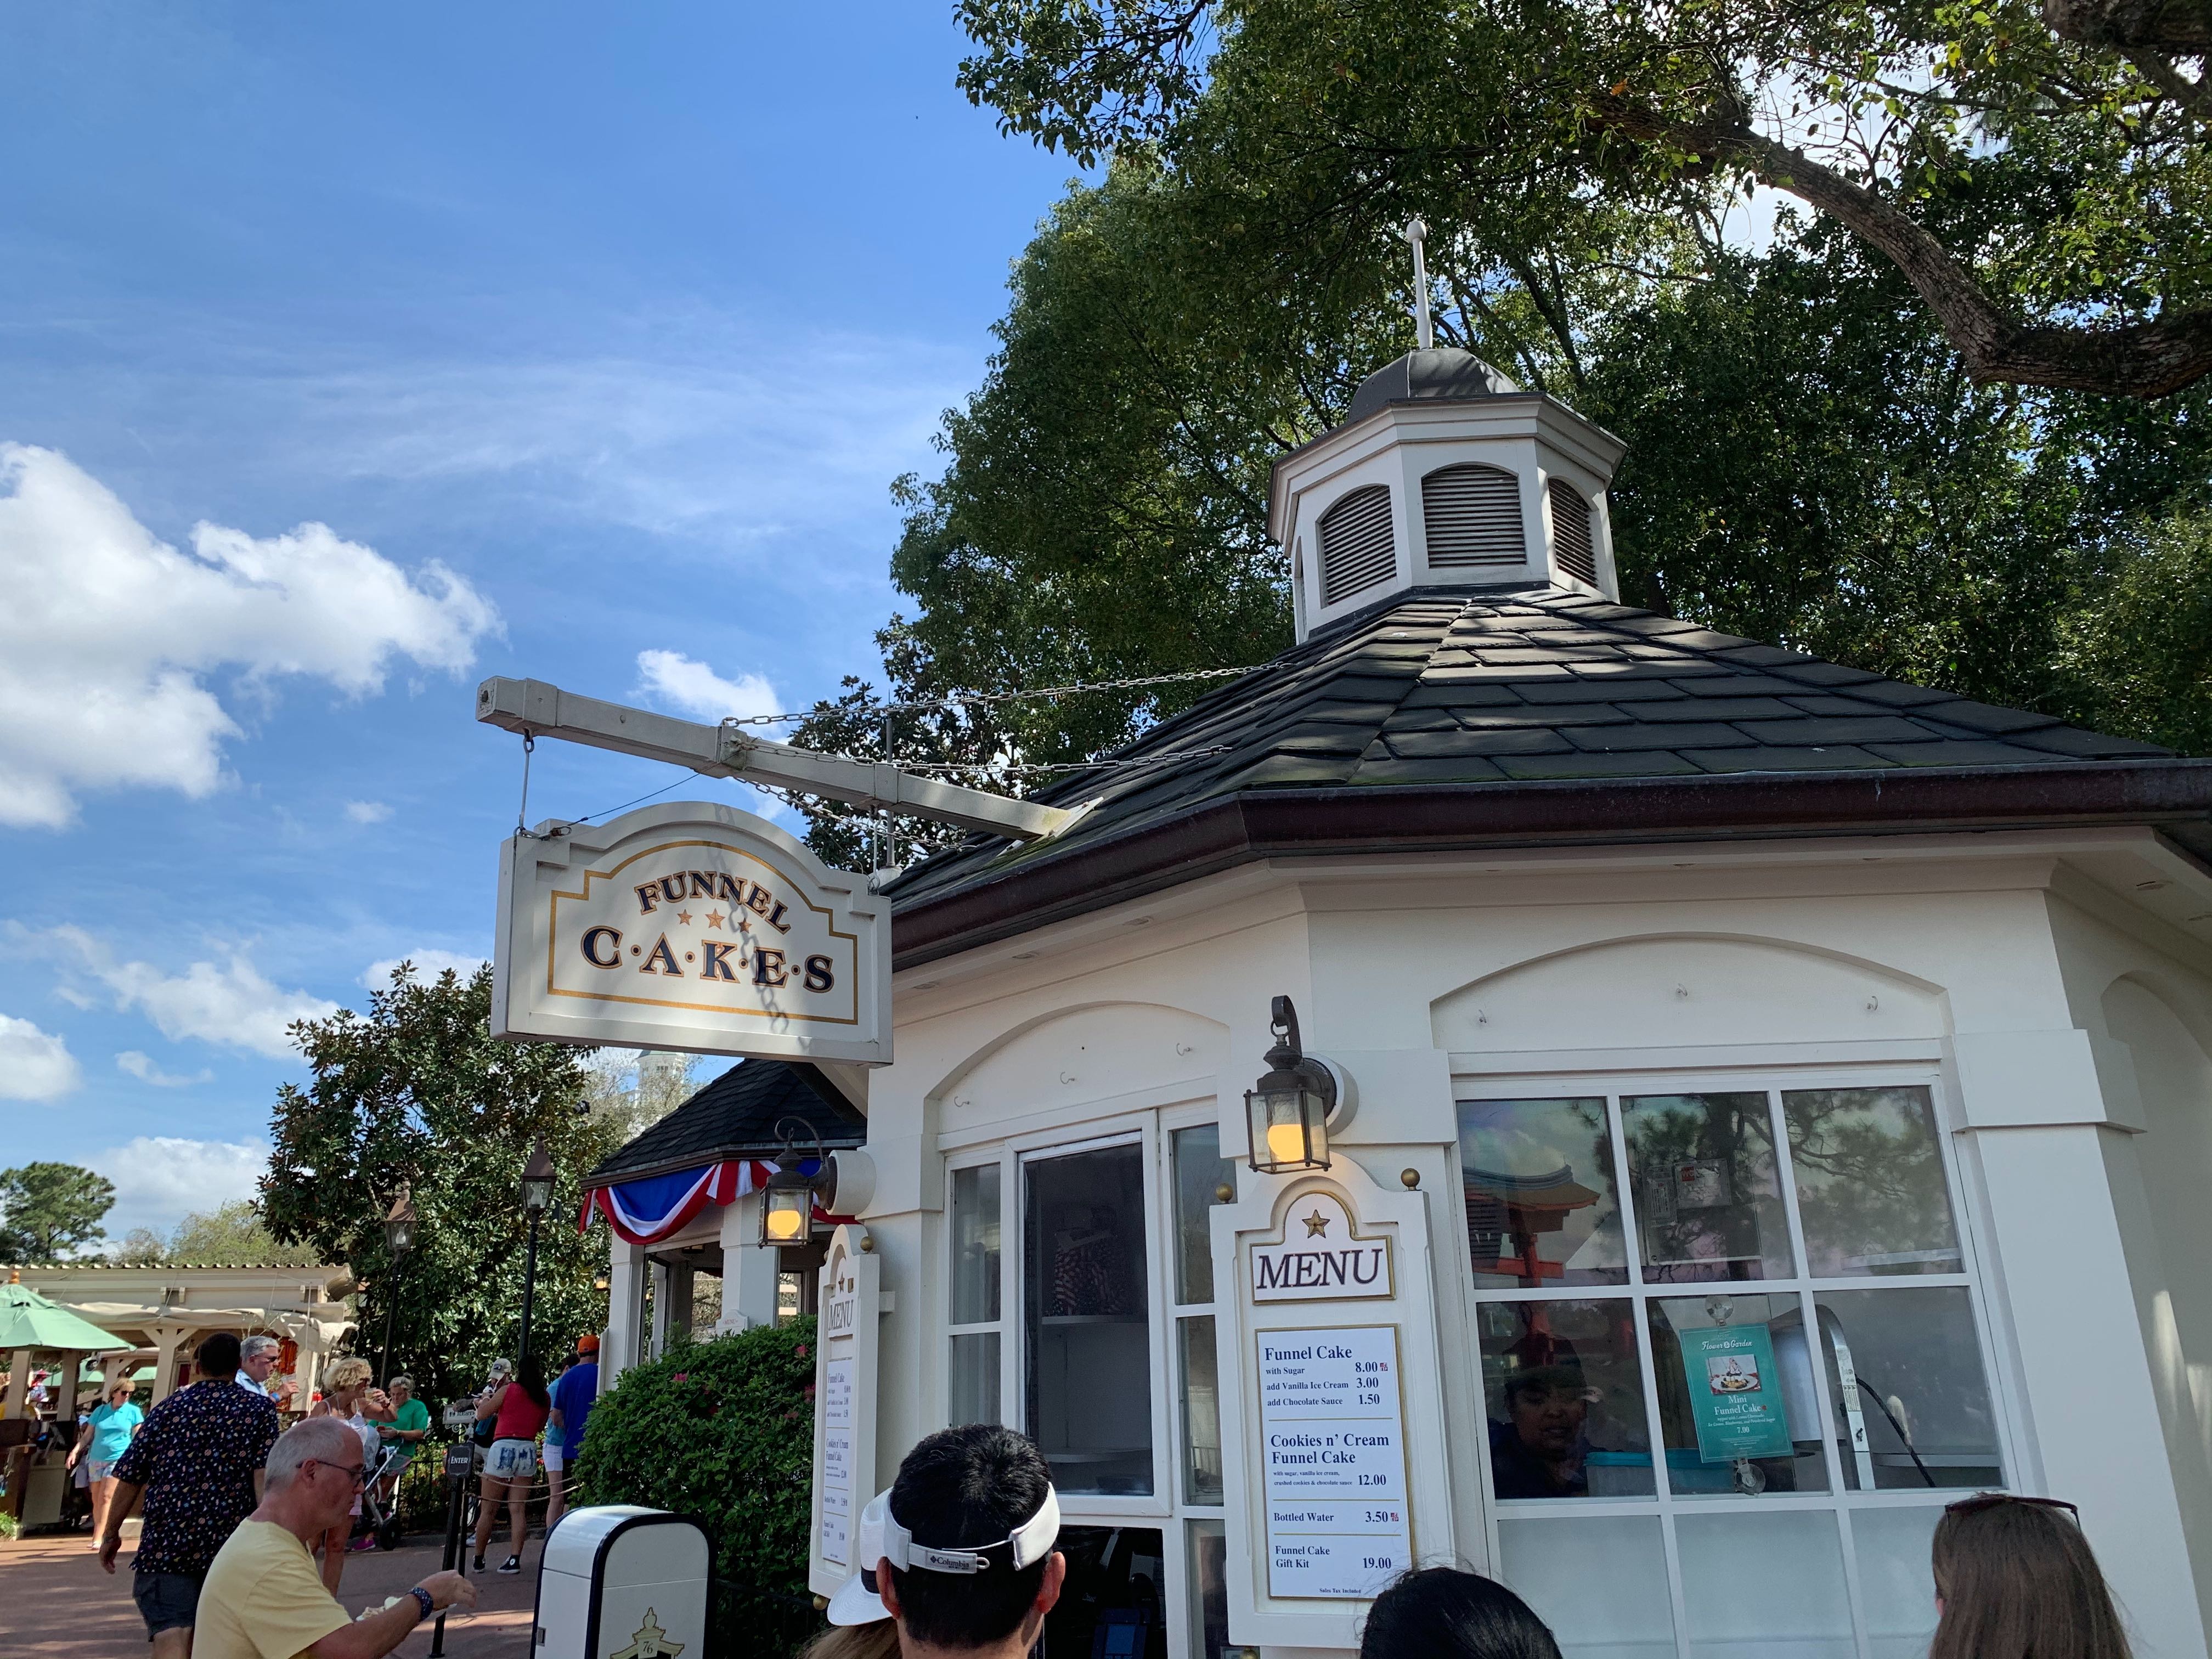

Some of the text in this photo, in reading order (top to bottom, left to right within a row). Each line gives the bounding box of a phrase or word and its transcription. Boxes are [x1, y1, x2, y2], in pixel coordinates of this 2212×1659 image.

[634, 870, 791, 934] FUNNEL
[1256, 1248, 1383, 1289] MENU
[828, 1299, 854, 1331] MENU
[1702, 1341, 1723, 1350] Flower
[1730, 1339, 1753, 1347] Garden
[1265, 1345, 1352, 1361] Funnel Cake
[1283, 1367, 1305, 1376] Sugar
[1355, 1361, 1378, 1373] 8.00
[1356, 1377, 1379, 1389] 3.00
[1358, 1393, 1380, 1404] 1.50
[1714, 1404, 1761, 1415] Funnel Cake
[1271, 1434, 1322, 1447] Cookies
[1344, 1433, 1389, 1446] Cream
[1272, 1451, 1356, 1464] Funnel Cake
[1358, 1474, 1386, 1486] 12.00
[1273, 1511, 1389, 1522] Bottled Water 3.50
[1275, 1545, 1330, 1555] Funnel Cake
[938, 1557, 969, 1567] Columbia
[1276, 1557, 1391, 1569] Gift Kit 19.00
[642, 1641, 654, 1654] 76
